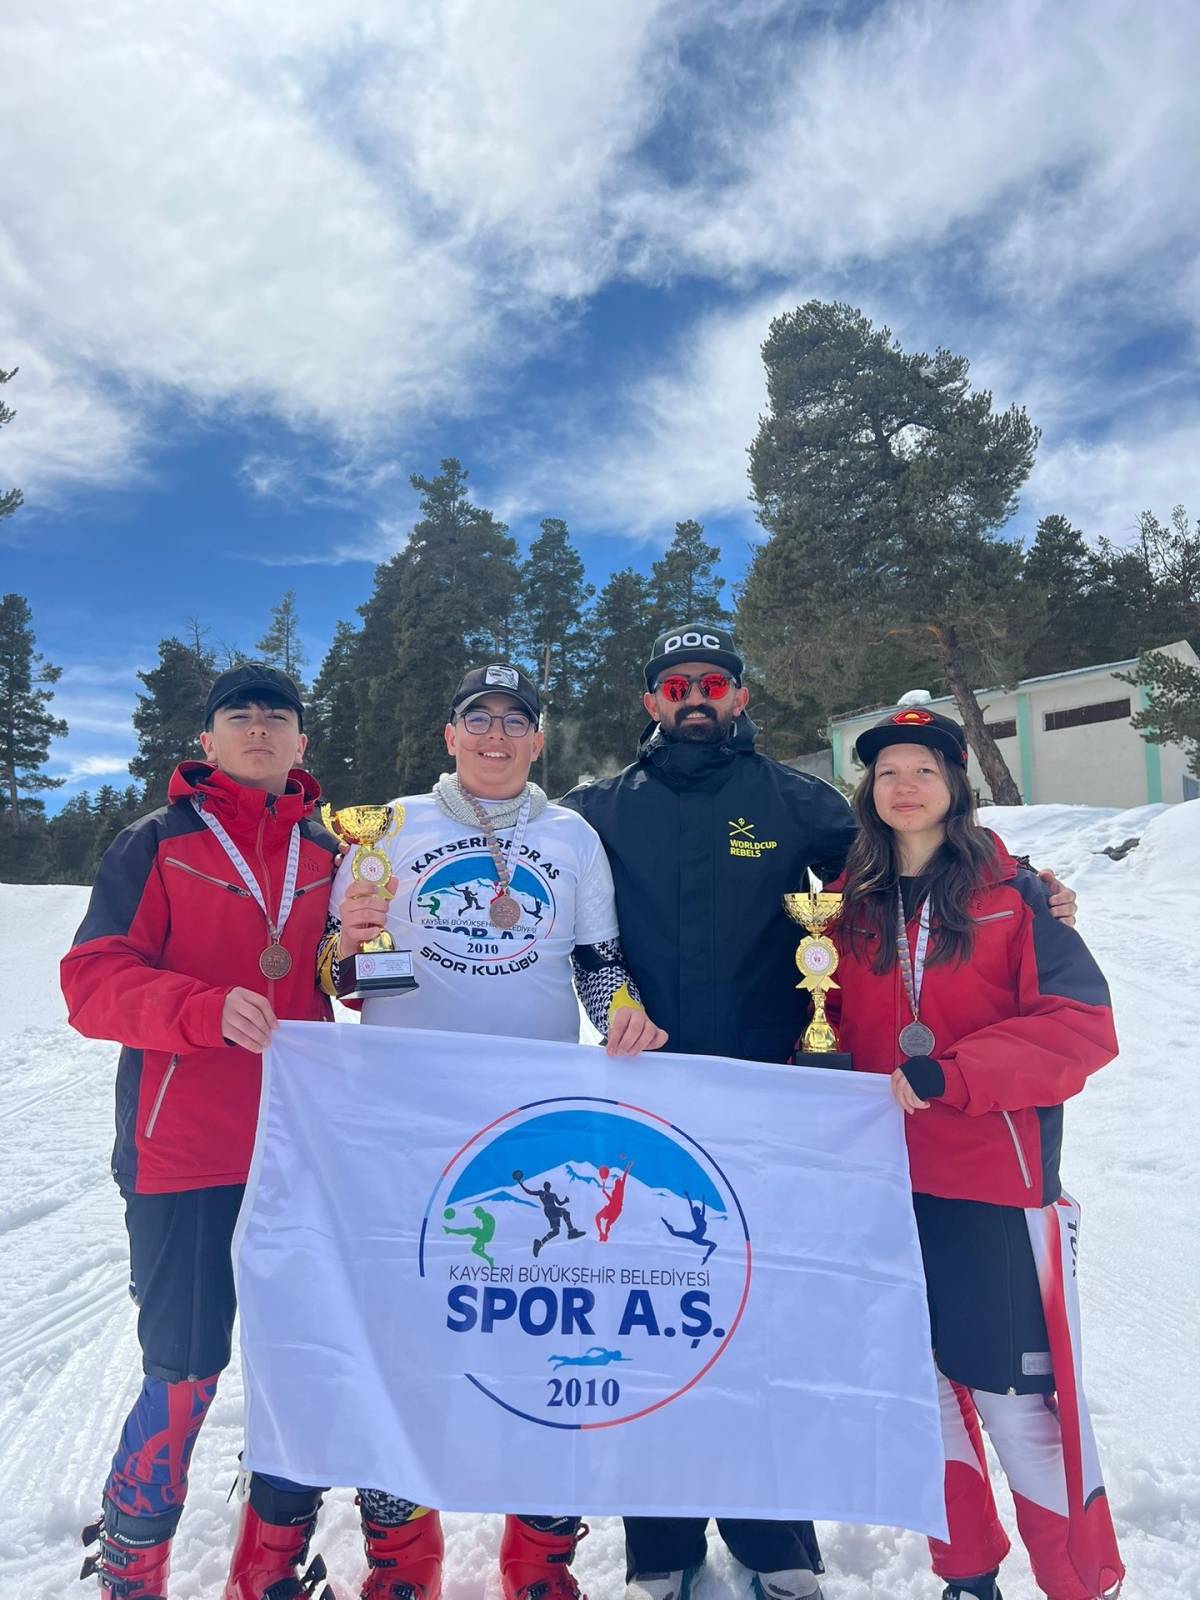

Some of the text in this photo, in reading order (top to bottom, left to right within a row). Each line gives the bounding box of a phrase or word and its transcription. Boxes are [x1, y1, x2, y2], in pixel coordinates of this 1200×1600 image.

[730, 839, 778, 850] WORLDCUP
[730, 847, 762, 858] REBELS
[466, 942, 499, 955] 2010
[420, 946, 468, 974] SPOR
[471, 950, 539, 976] KULÜBÜ
[449, 1264, 711, 1287] KAYSERİ BÜYÜKŞEHİR BELEDİYESİ
[446, 1284, 726, 1349] SPOR A.Ş.
[545, 1377, 620, 1408] 2010
